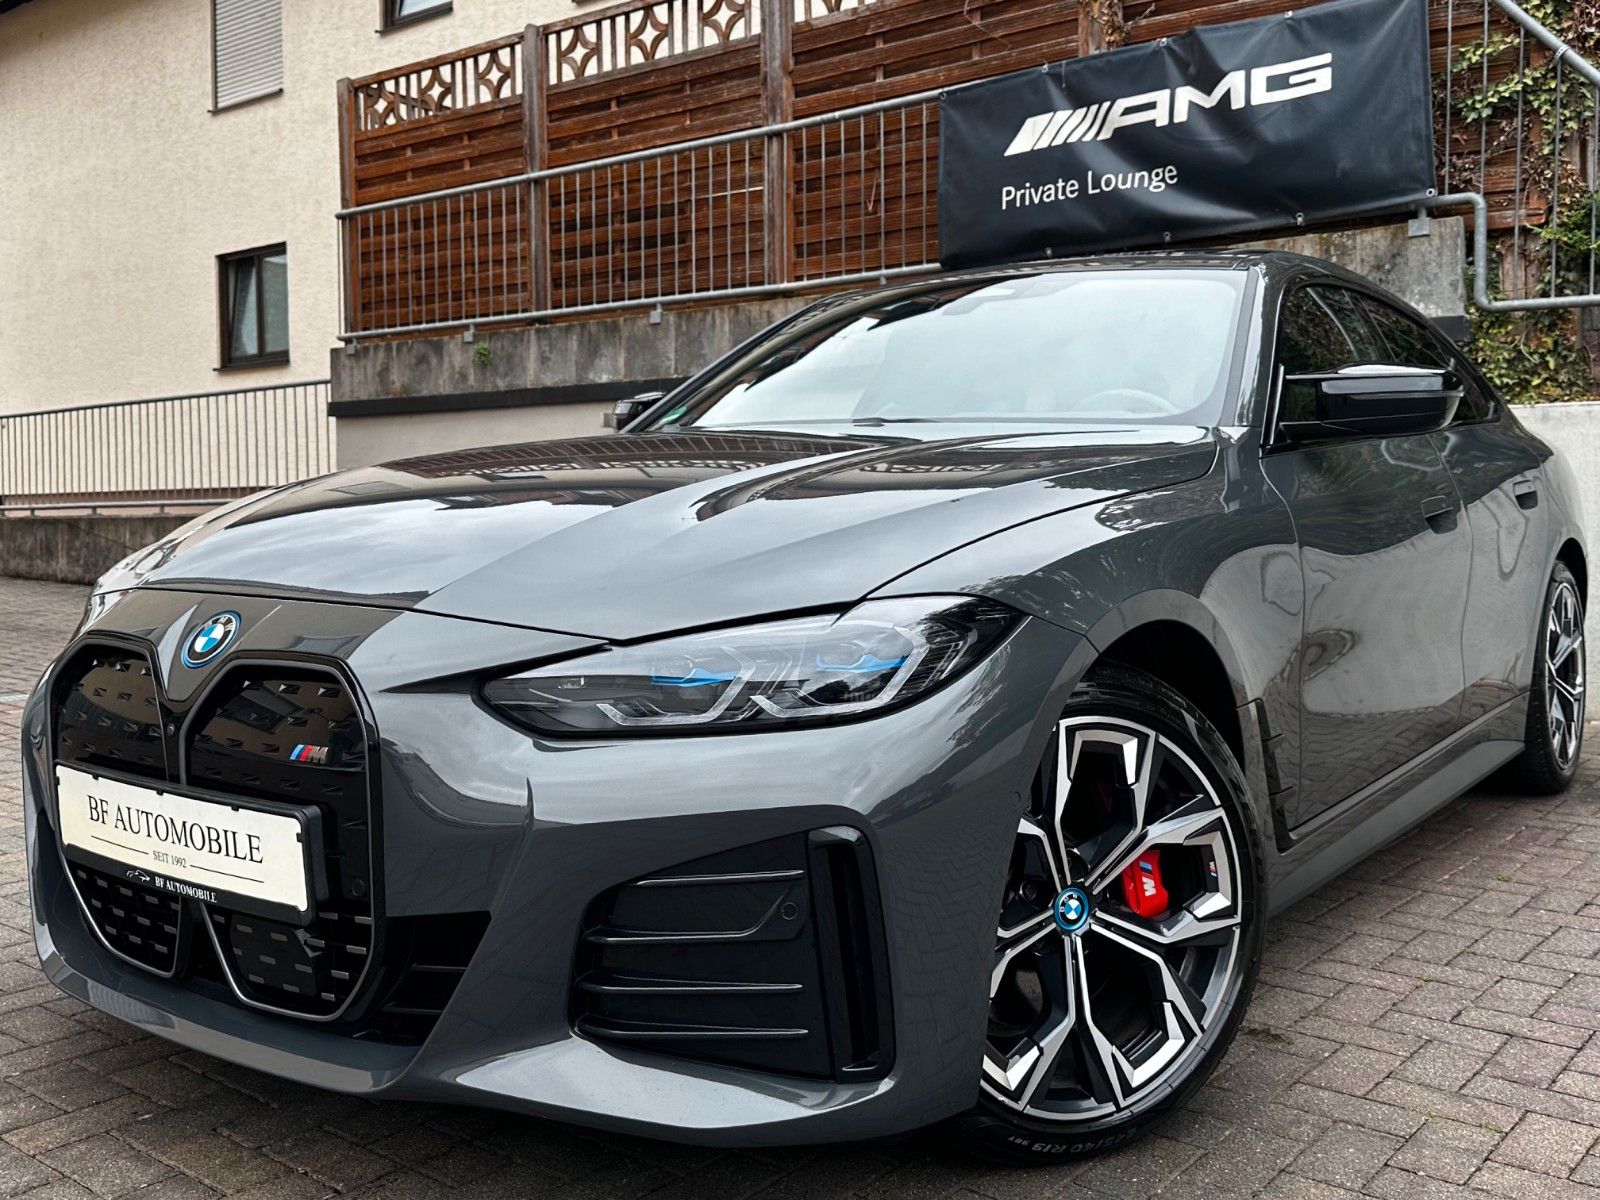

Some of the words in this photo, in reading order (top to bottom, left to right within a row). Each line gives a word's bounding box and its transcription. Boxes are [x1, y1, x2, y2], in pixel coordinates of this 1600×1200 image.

[1096, 52, 1333, 141] AMG
[1001, 178, 1080, 210] Private
[1087, 164, 1178, 193] Lounge
[87, 794, 109, 825] BF
[114, 803, 264, 865] AUTOMOBILE
[152, 849, 170, 864] SEIT
[171, 855, 187, 868] 1992
[155, 876, 165, 888] BF
[166, 880, 218, 904] AUTOMOBILE
[1031, 1142, 1067, 1153] R19
